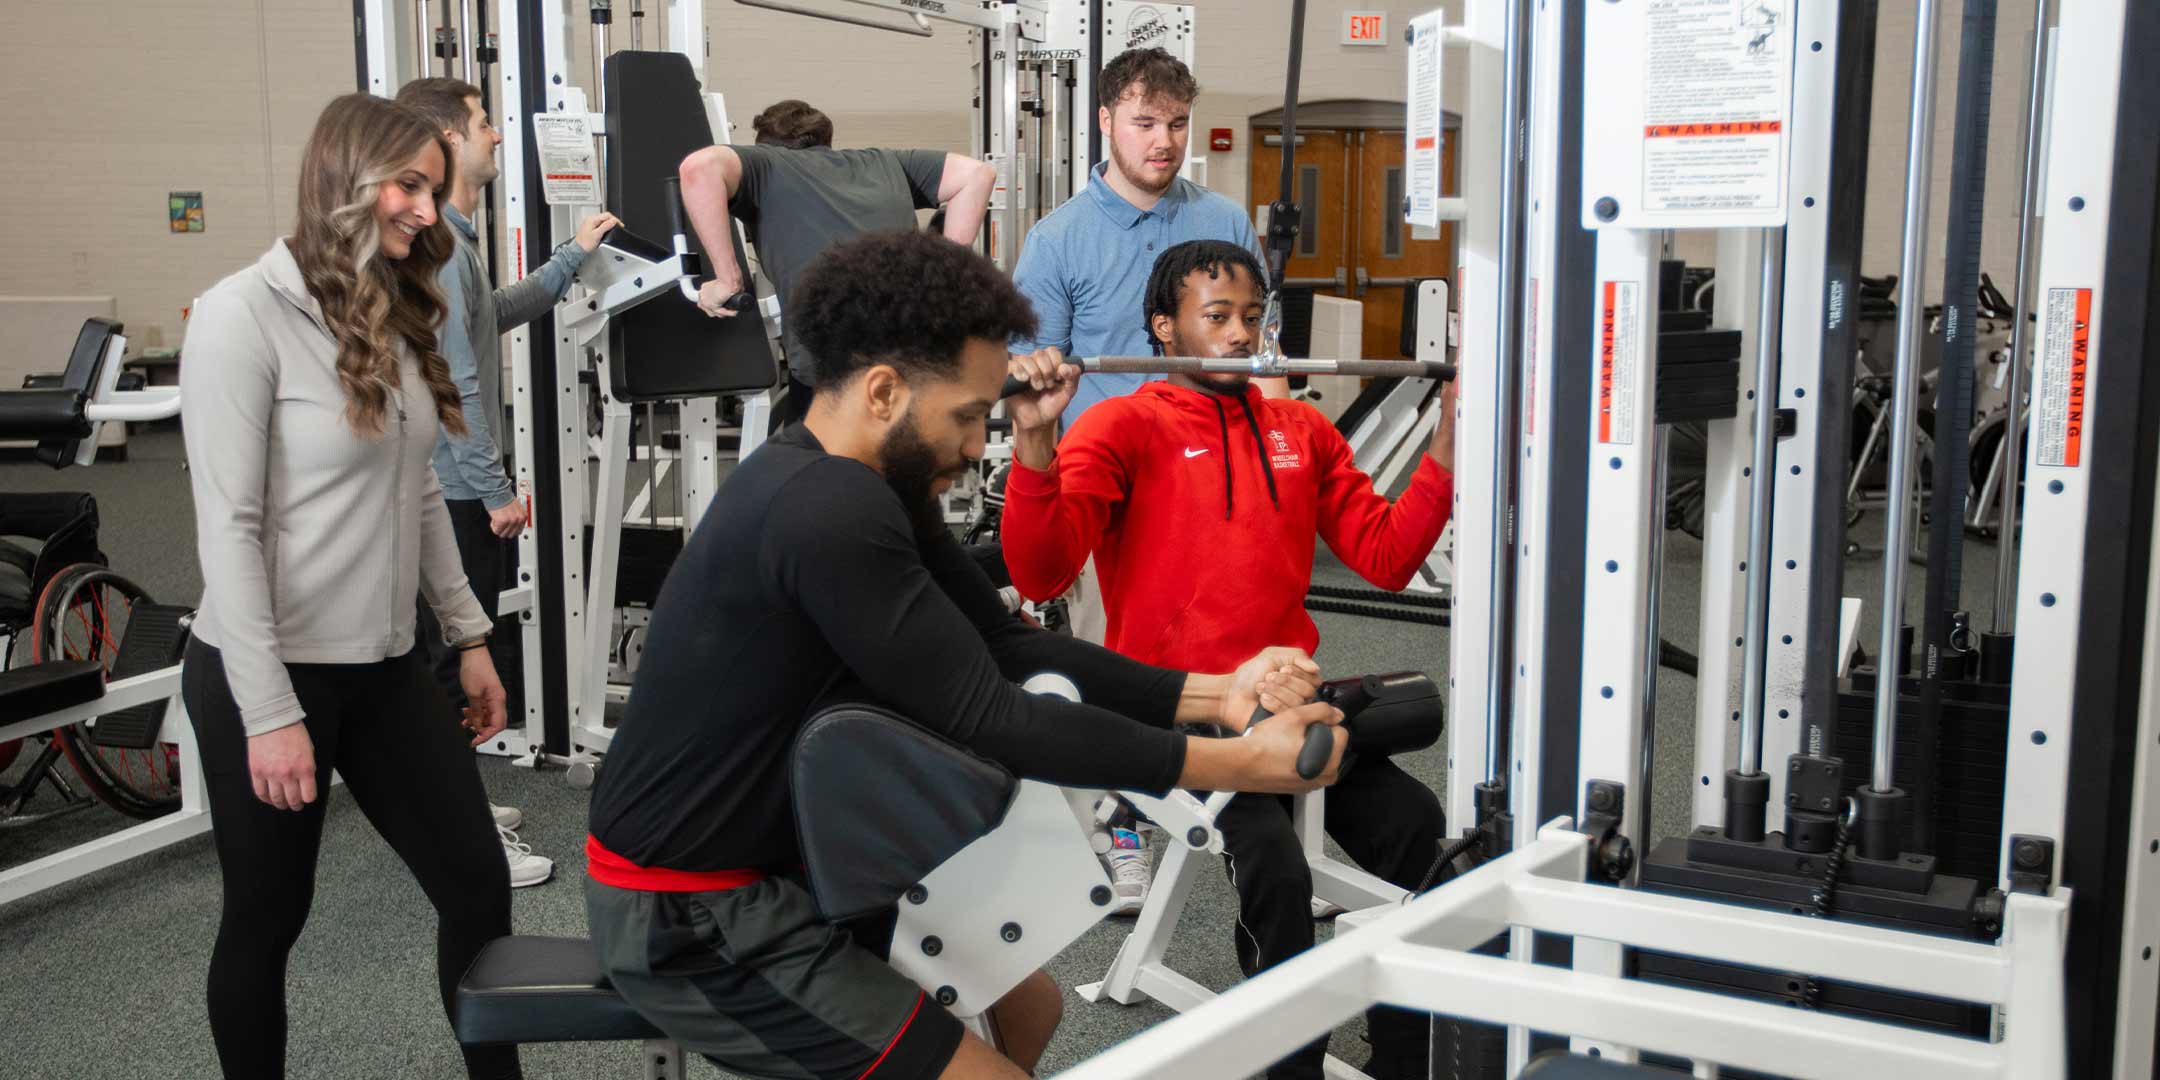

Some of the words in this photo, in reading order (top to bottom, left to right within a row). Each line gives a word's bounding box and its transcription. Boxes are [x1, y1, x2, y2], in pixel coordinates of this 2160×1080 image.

[1351, 15, 1382, 40] EXIT
[994, 50, 1029, 60] BY
[1668, 121, 1779, 136] WARNING
[1600, 308, 1614, 399] WARNING
[2067, 337, 2087, 438] WARNING
